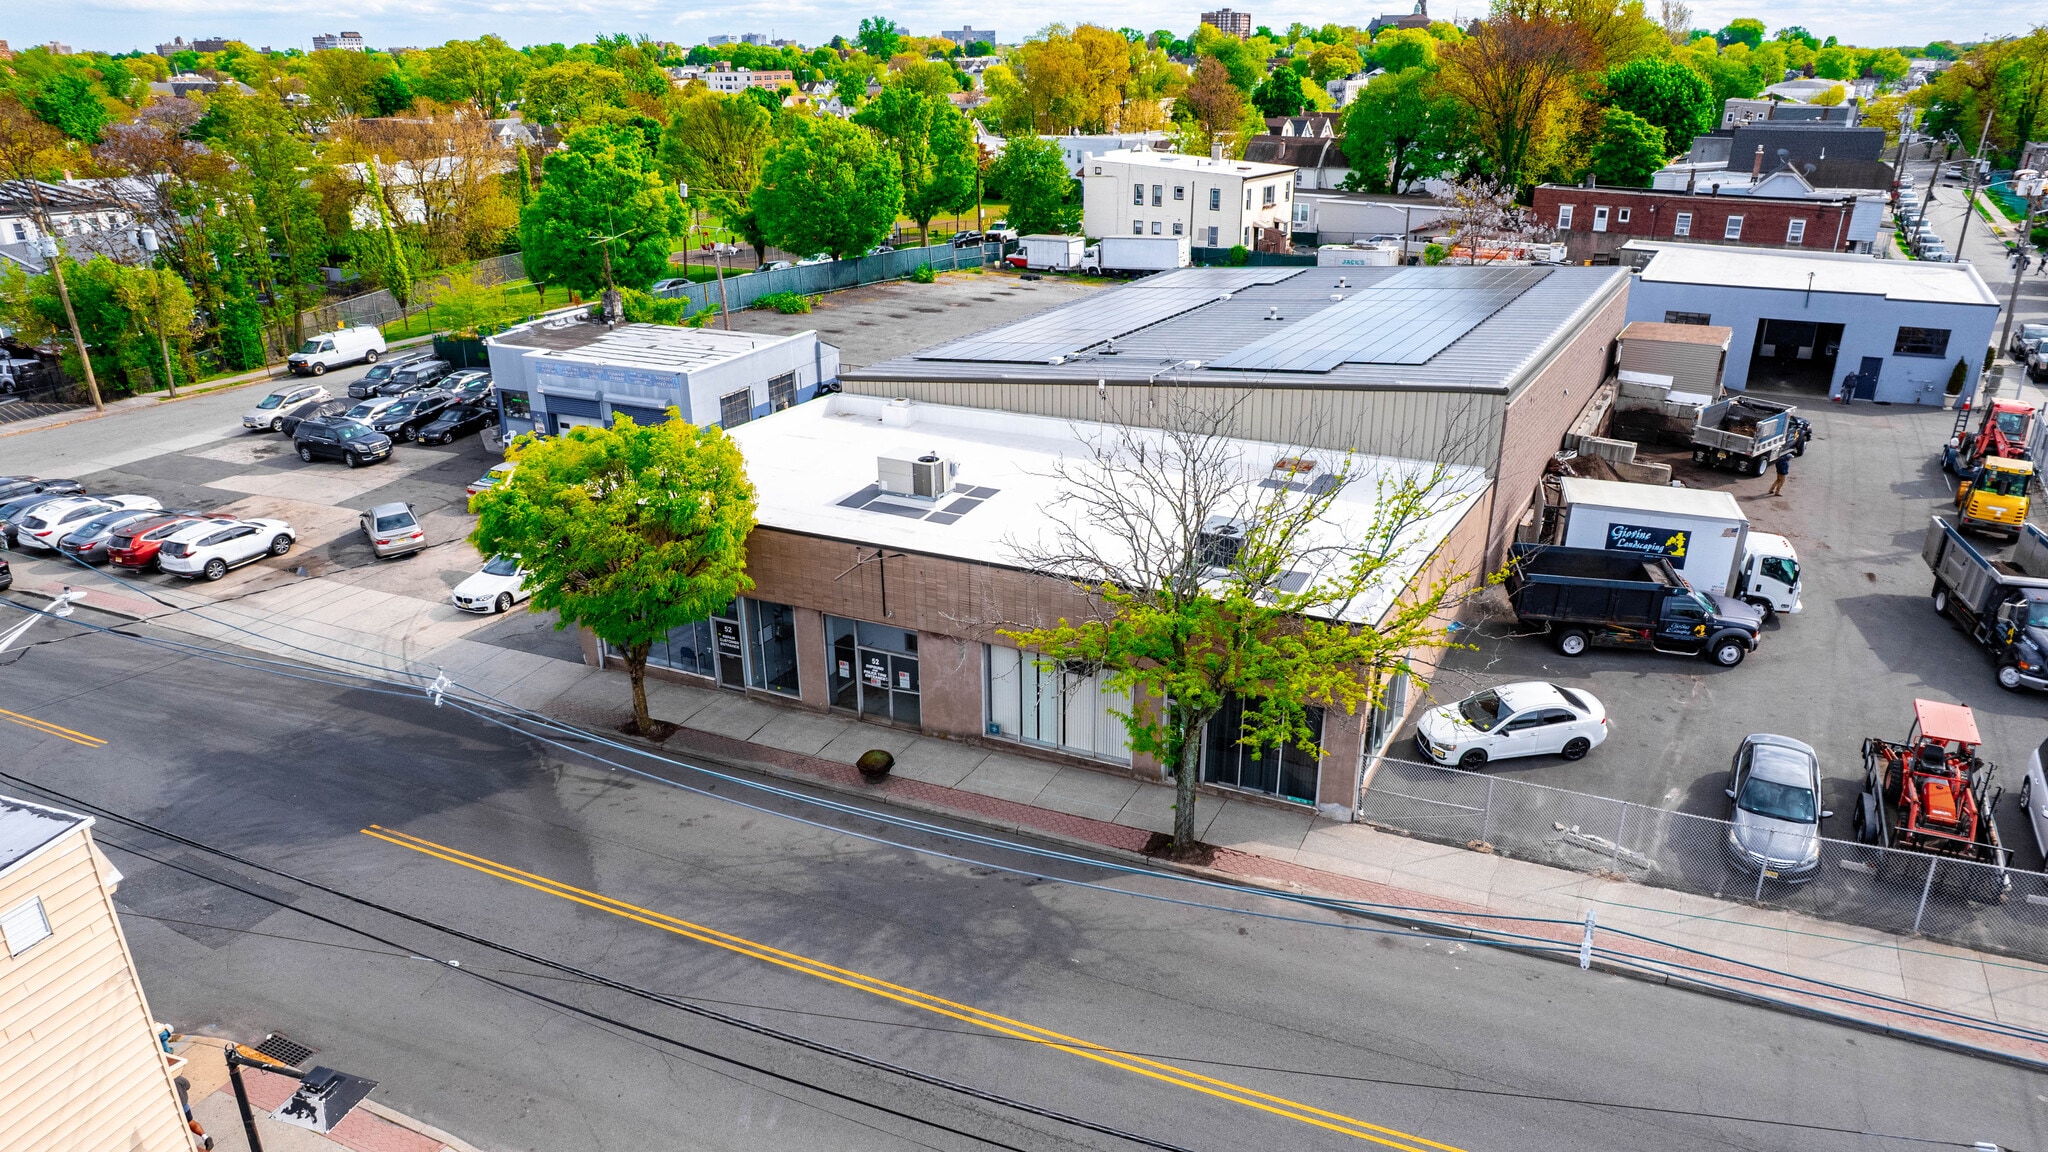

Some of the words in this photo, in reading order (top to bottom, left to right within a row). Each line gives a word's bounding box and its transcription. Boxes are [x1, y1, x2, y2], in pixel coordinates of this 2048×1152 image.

[1611, 525, 1652, 540] Giovine
[1616, 538, 1665, 553] Landscaping
[724, 625, 733, 634] 52
[871, 657, 880, 665] 52
